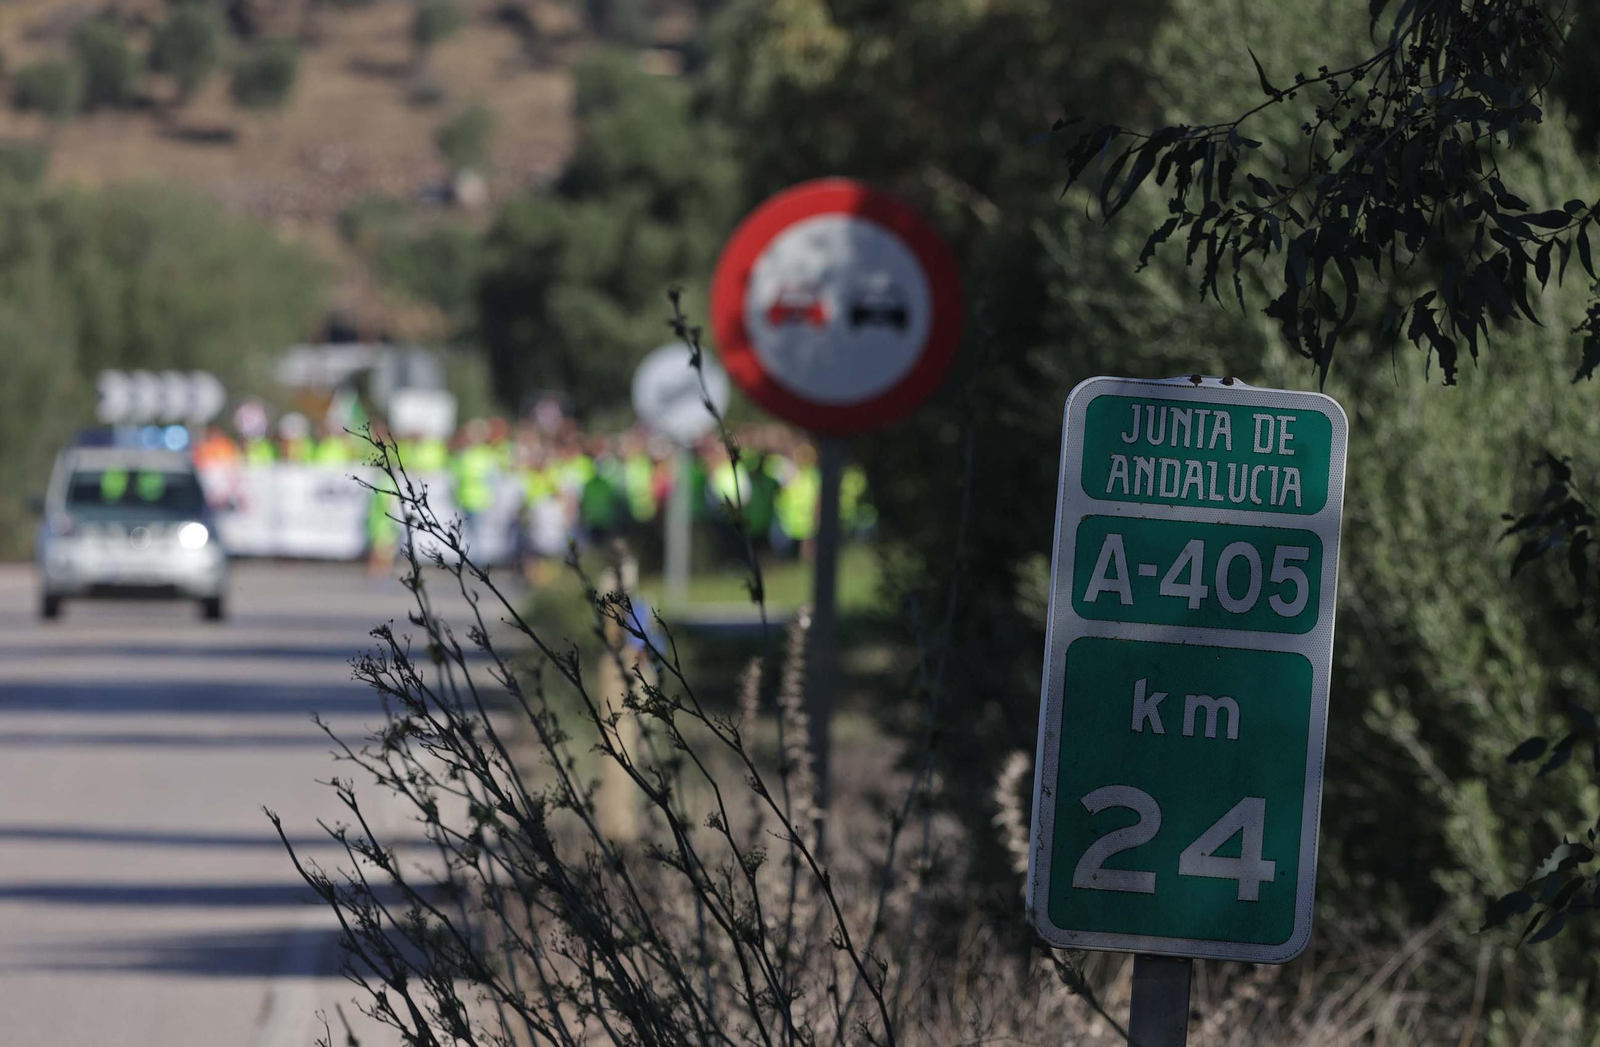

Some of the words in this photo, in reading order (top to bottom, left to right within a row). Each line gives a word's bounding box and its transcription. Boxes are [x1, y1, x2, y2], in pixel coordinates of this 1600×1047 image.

[1121, 404, 1232, 451] JUNTA
[1252, 413, 1297, 456] DE
[1106, 454, 1302, 507] ANDALUCIA
[1083, 533, 1310, 618] A-405
[1130, 677, 1241, 740] km
[1072, 785, 1276, 902] 24
